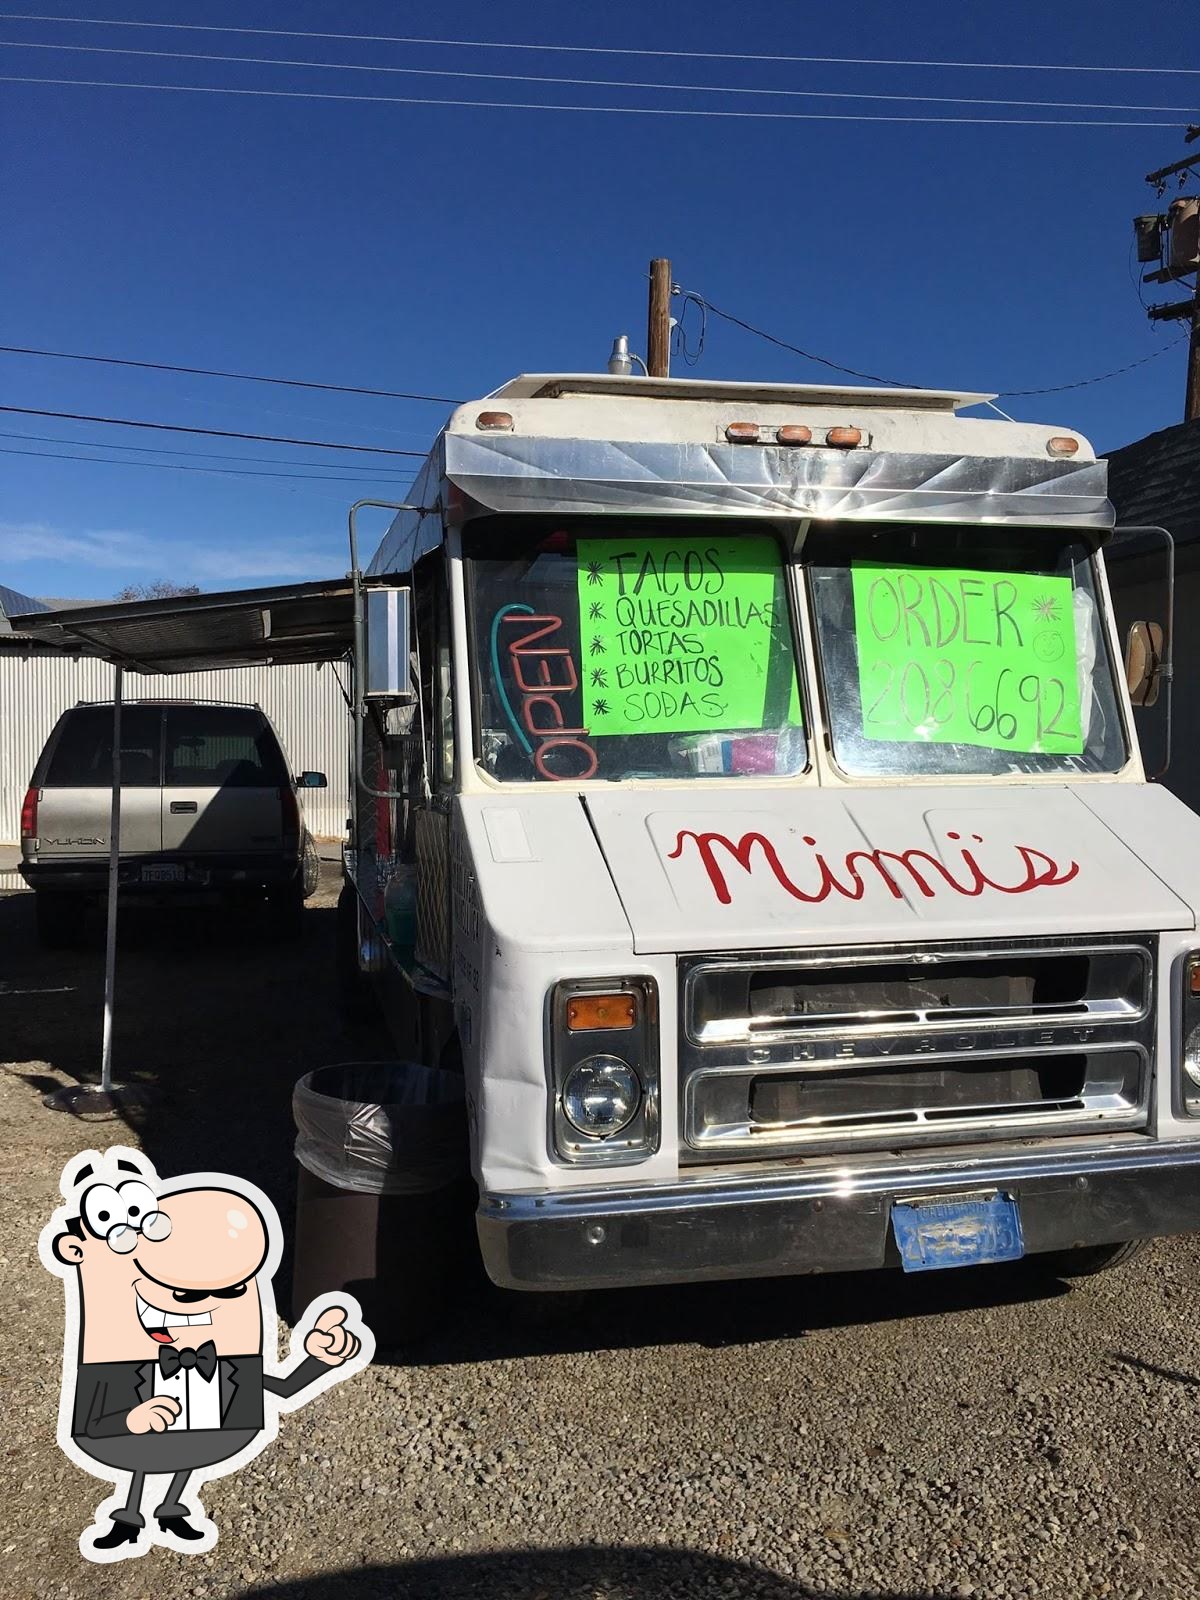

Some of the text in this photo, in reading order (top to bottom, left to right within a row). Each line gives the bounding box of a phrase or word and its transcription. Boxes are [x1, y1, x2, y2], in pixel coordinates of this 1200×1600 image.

[608, 548, 724, 597] TACOS
[615, 597, 778, 629] QUESADILLAS
[867, 574, 1024, 648] ORDER
[615, 629, 704, 656] TORTAS
[615, 655, 723, 688] BURRITOS
[503, 614, 599, 781] OPEN
[623, 692, 724, 721] SODAS
[43, 837, 106, 846] YUKON
[746, 1029, 1095, 1064] CHEVROLET
